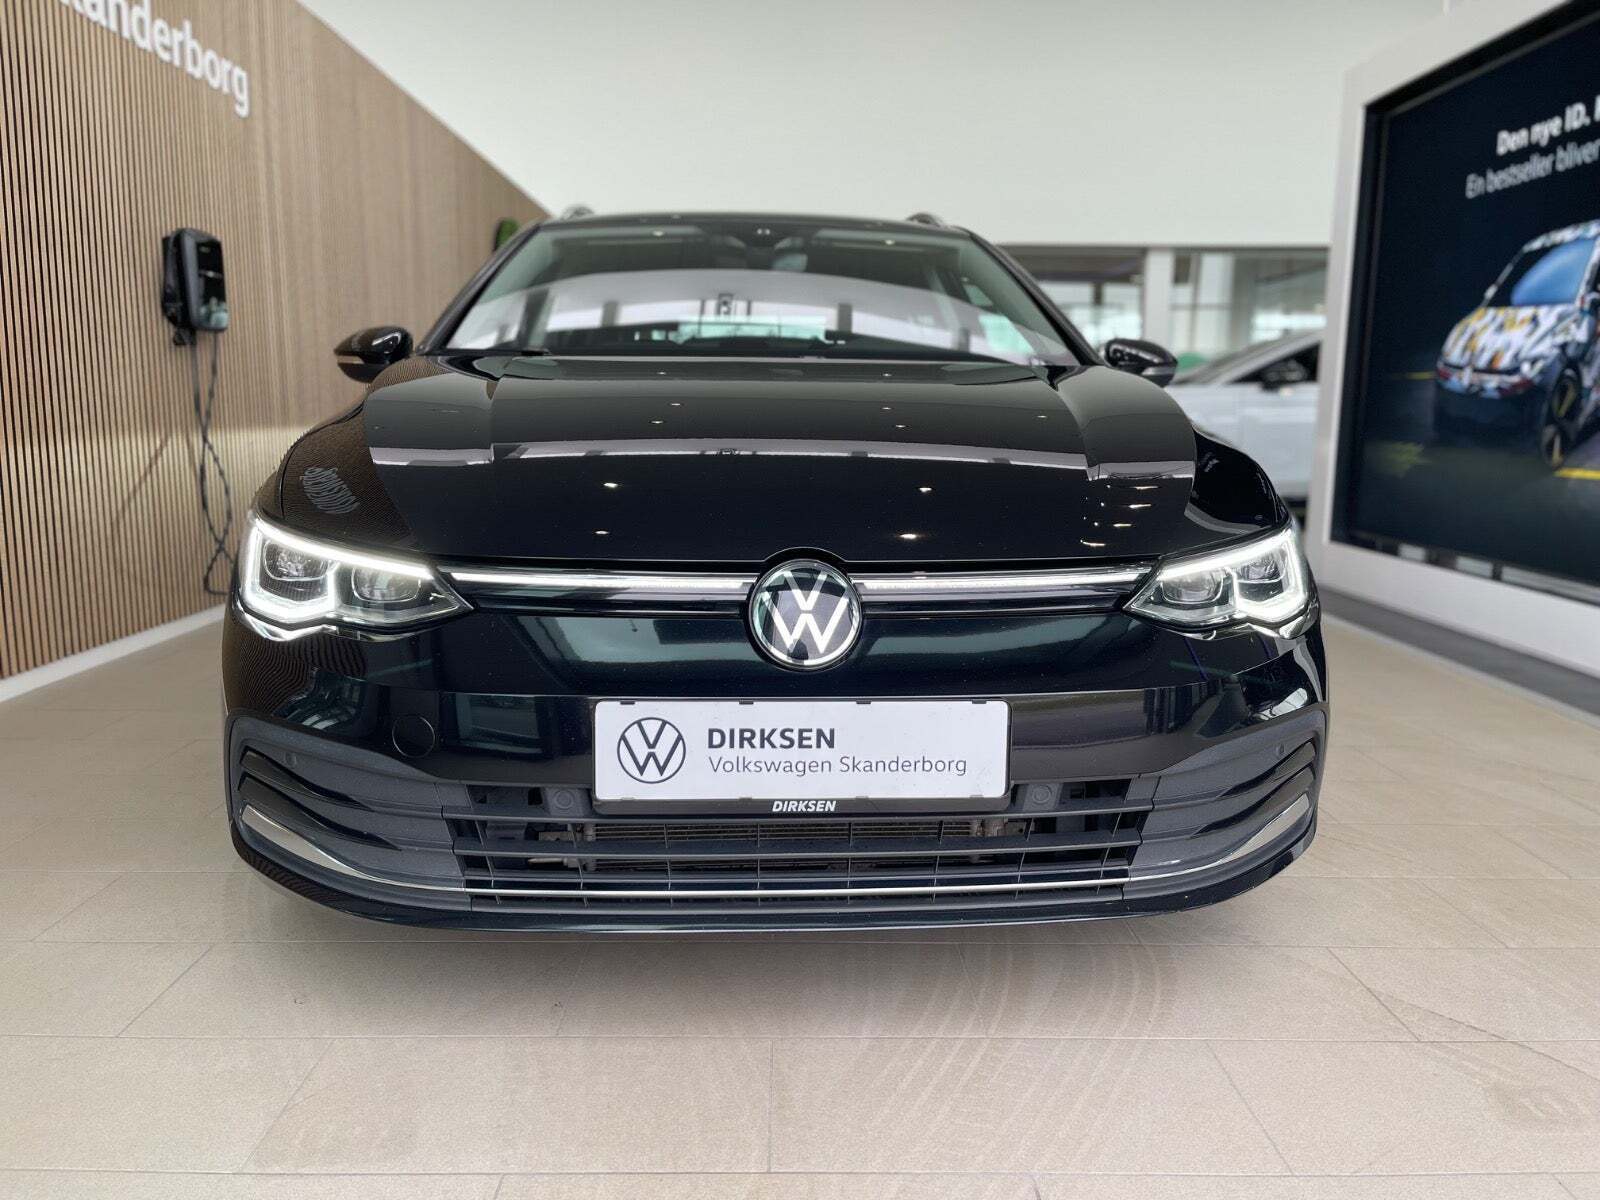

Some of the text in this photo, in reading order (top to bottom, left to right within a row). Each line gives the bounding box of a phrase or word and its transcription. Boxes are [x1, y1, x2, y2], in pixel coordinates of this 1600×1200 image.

[60, 0, 249, 117] anderborg
[1496, 129, 1529, 156] Den
[1530, 116, 1562, 147] nye
[1465, 173, 1485, 199] En
[1486, 152, 1554, 193] bestseller
[707, 727, 836, 749] DIRKSEN
[708, 755, 967, 777] Volkswagen Skanderborg
[772, 800, 837, 812] DIRKSEN
